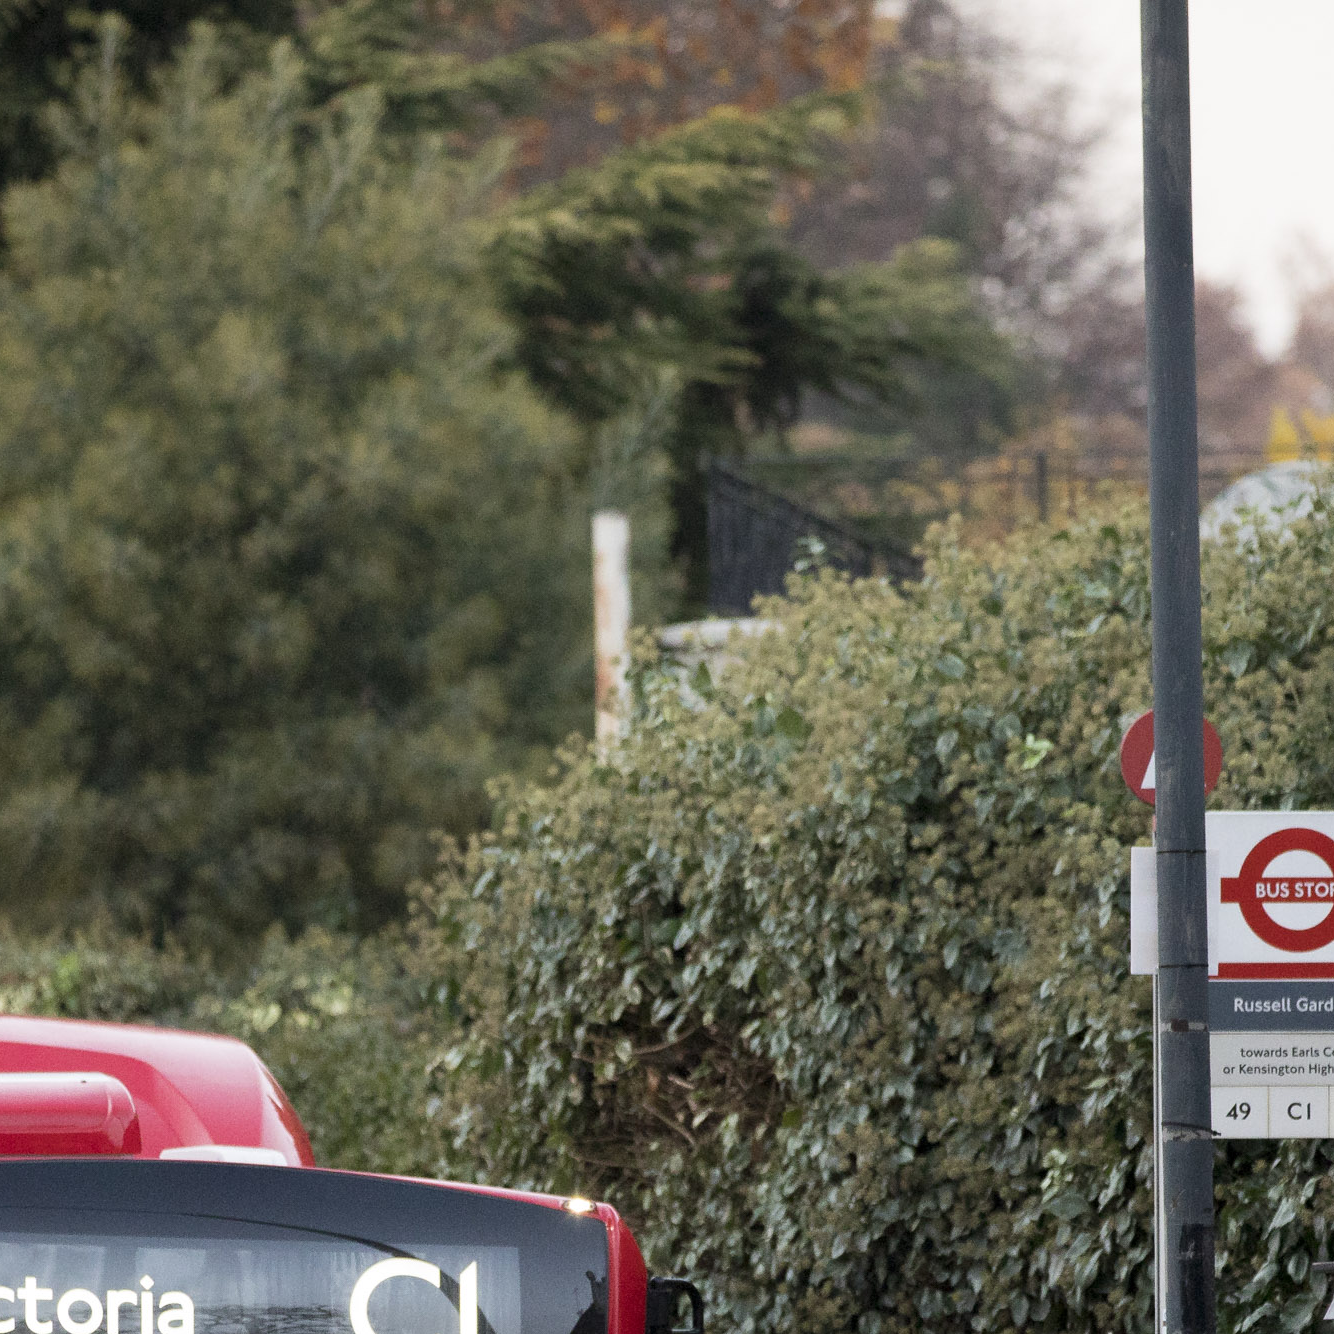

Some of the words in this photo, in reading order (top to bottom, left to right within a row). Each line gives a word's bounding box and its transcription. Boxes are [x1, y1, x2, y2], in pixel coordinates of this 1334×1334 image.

[1255, 882, 1292, 899] BUS
[1233, 996, 1292, 1013] Russell
[1240, 1046, 1289, 1058] towards
[1291, 1046, 1320, 1058] Earls
[1222, 1065, 1236, 1075] or
[1238, 1063, 1305, 1077] Kensington
[1308, 1063, 1334, 1077] High
[1226, 1102, 1252, 1120] 49
[1287, 1102, 1312, 1121] C1
